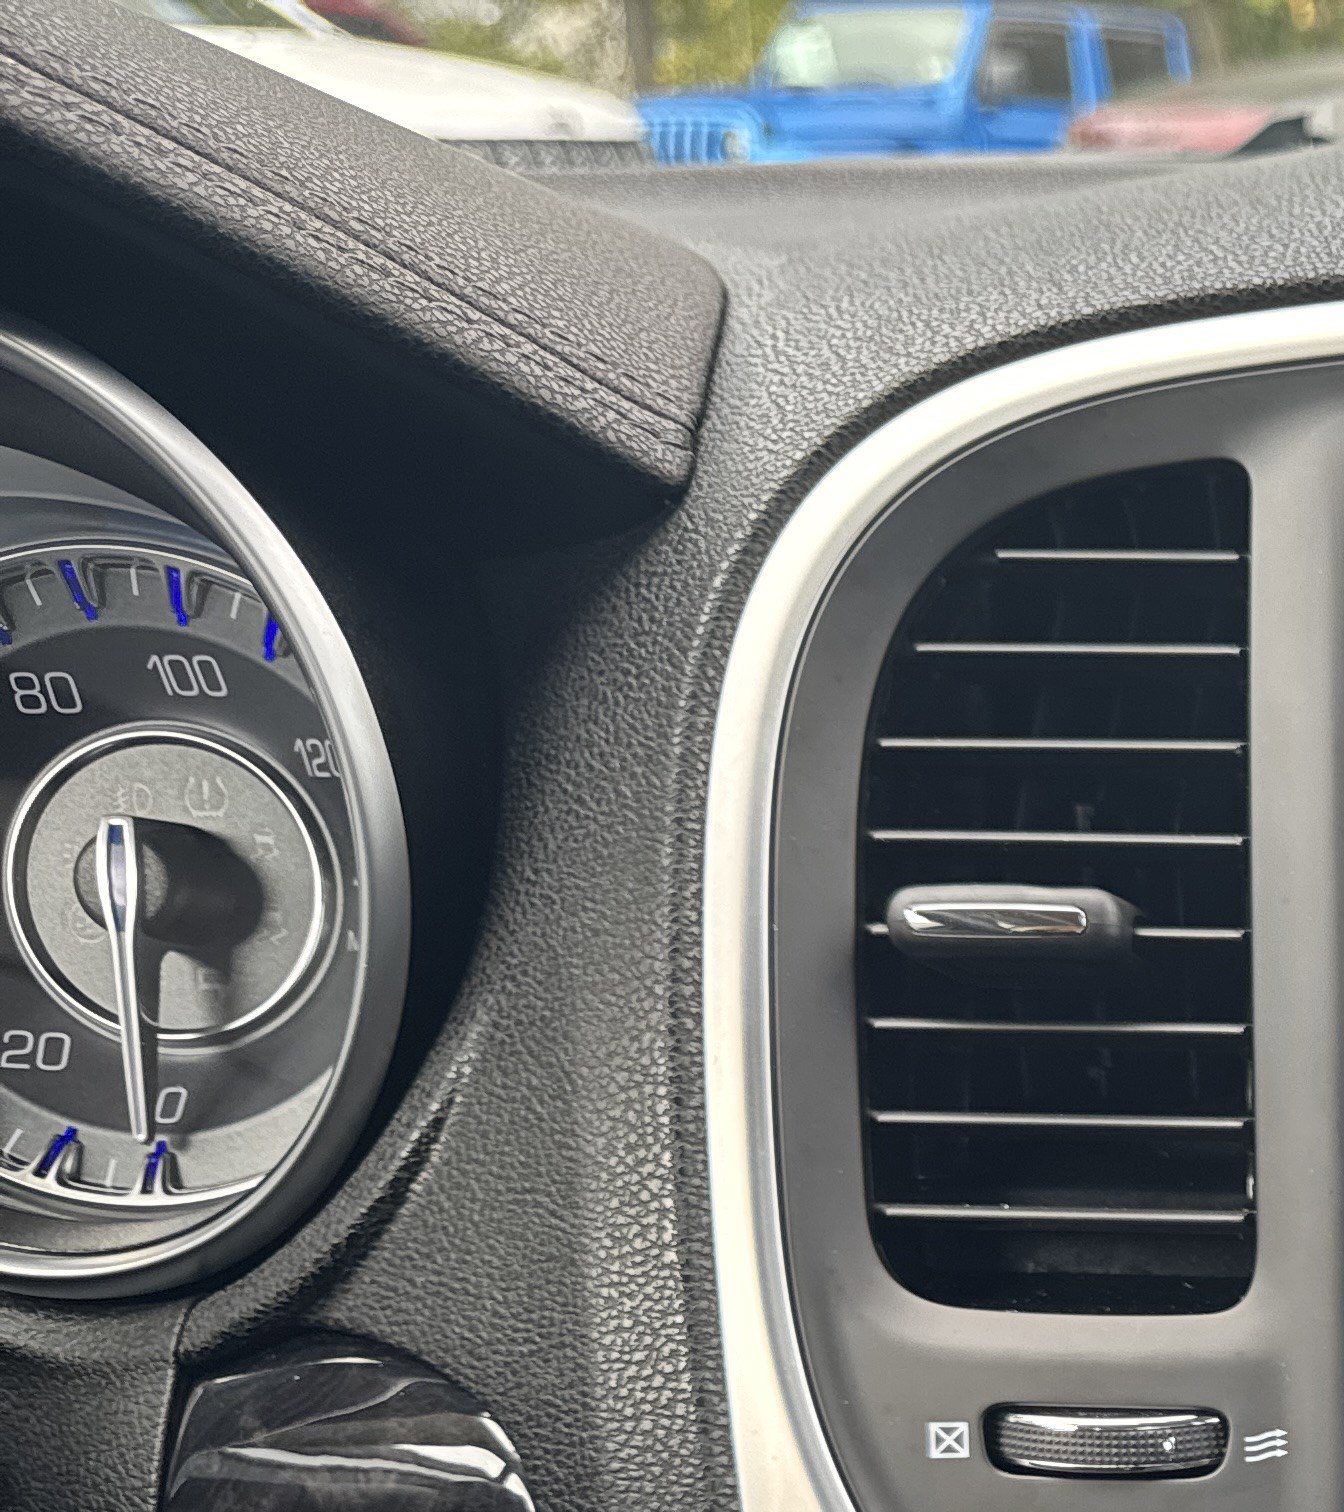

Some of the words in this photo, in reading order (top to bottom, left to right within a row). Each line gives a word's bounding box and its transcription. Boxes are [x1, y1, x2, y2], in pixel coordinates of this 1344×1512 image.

[9, 671, 83, 715] 80
[147, 654, 229, 698] 100
[0, 1030, 71, 1073] 20
[155, 1086, 189, 1125] 0
